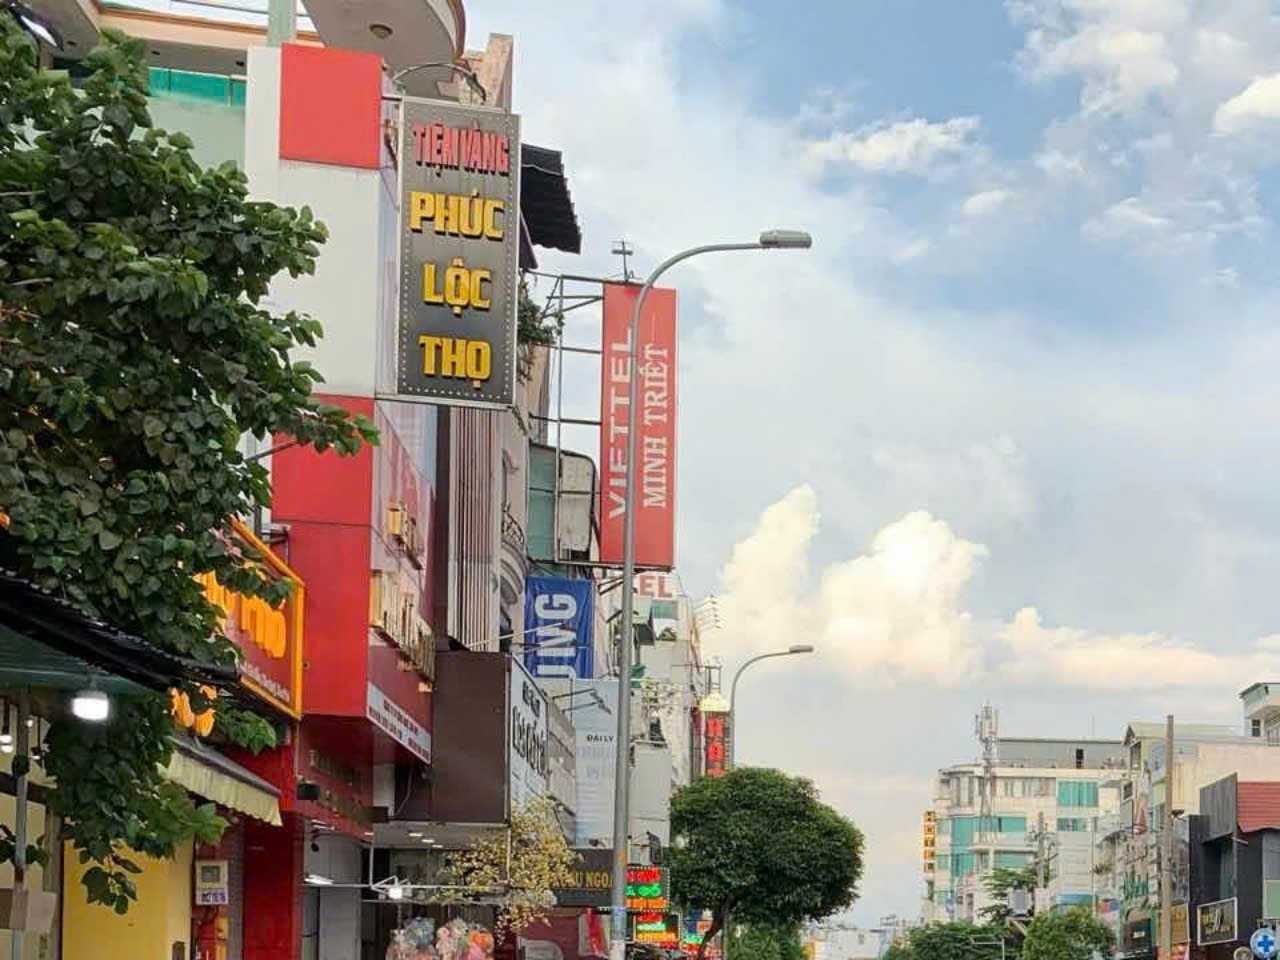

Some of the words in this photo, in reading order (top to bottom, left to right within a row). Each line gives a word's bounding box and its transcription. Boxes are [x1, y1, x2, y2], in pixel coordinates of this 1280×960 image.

[410, 189, 504, 240] PHÚC
[423, 257, 492, 316] LỘC
[418, 335, 491, 389] THỌ
[643, 436, 667, 508] MINH
[587, 734, 614, 742] DAILY
